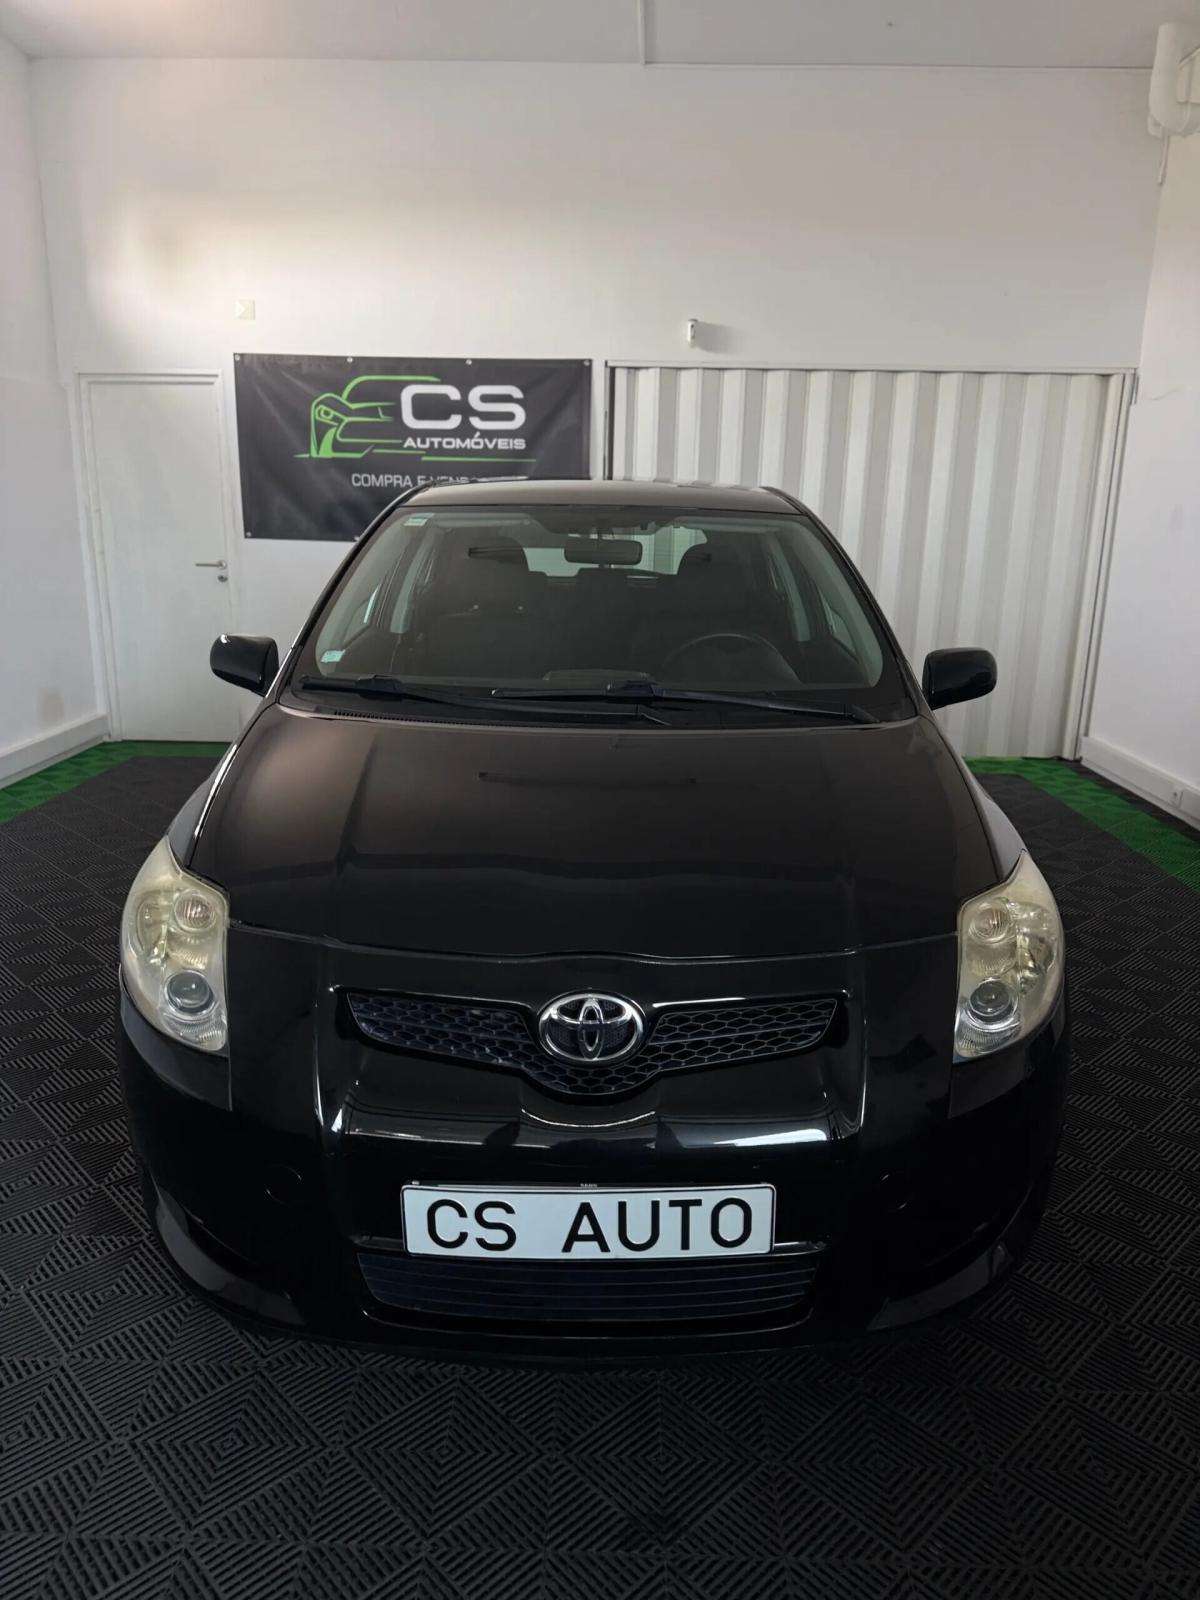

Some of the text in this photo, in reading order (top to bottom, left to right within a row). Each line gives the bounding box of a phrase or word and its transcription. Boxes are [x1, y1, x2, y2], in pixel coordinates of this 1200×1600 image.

[400, 384, 527, 431] CS
[403, 432, 526, 450] AUTOMÓVEIS
[351, 473, 413, 488] COMPRA
[426, 1197, 753, 1254] CS AUTO
